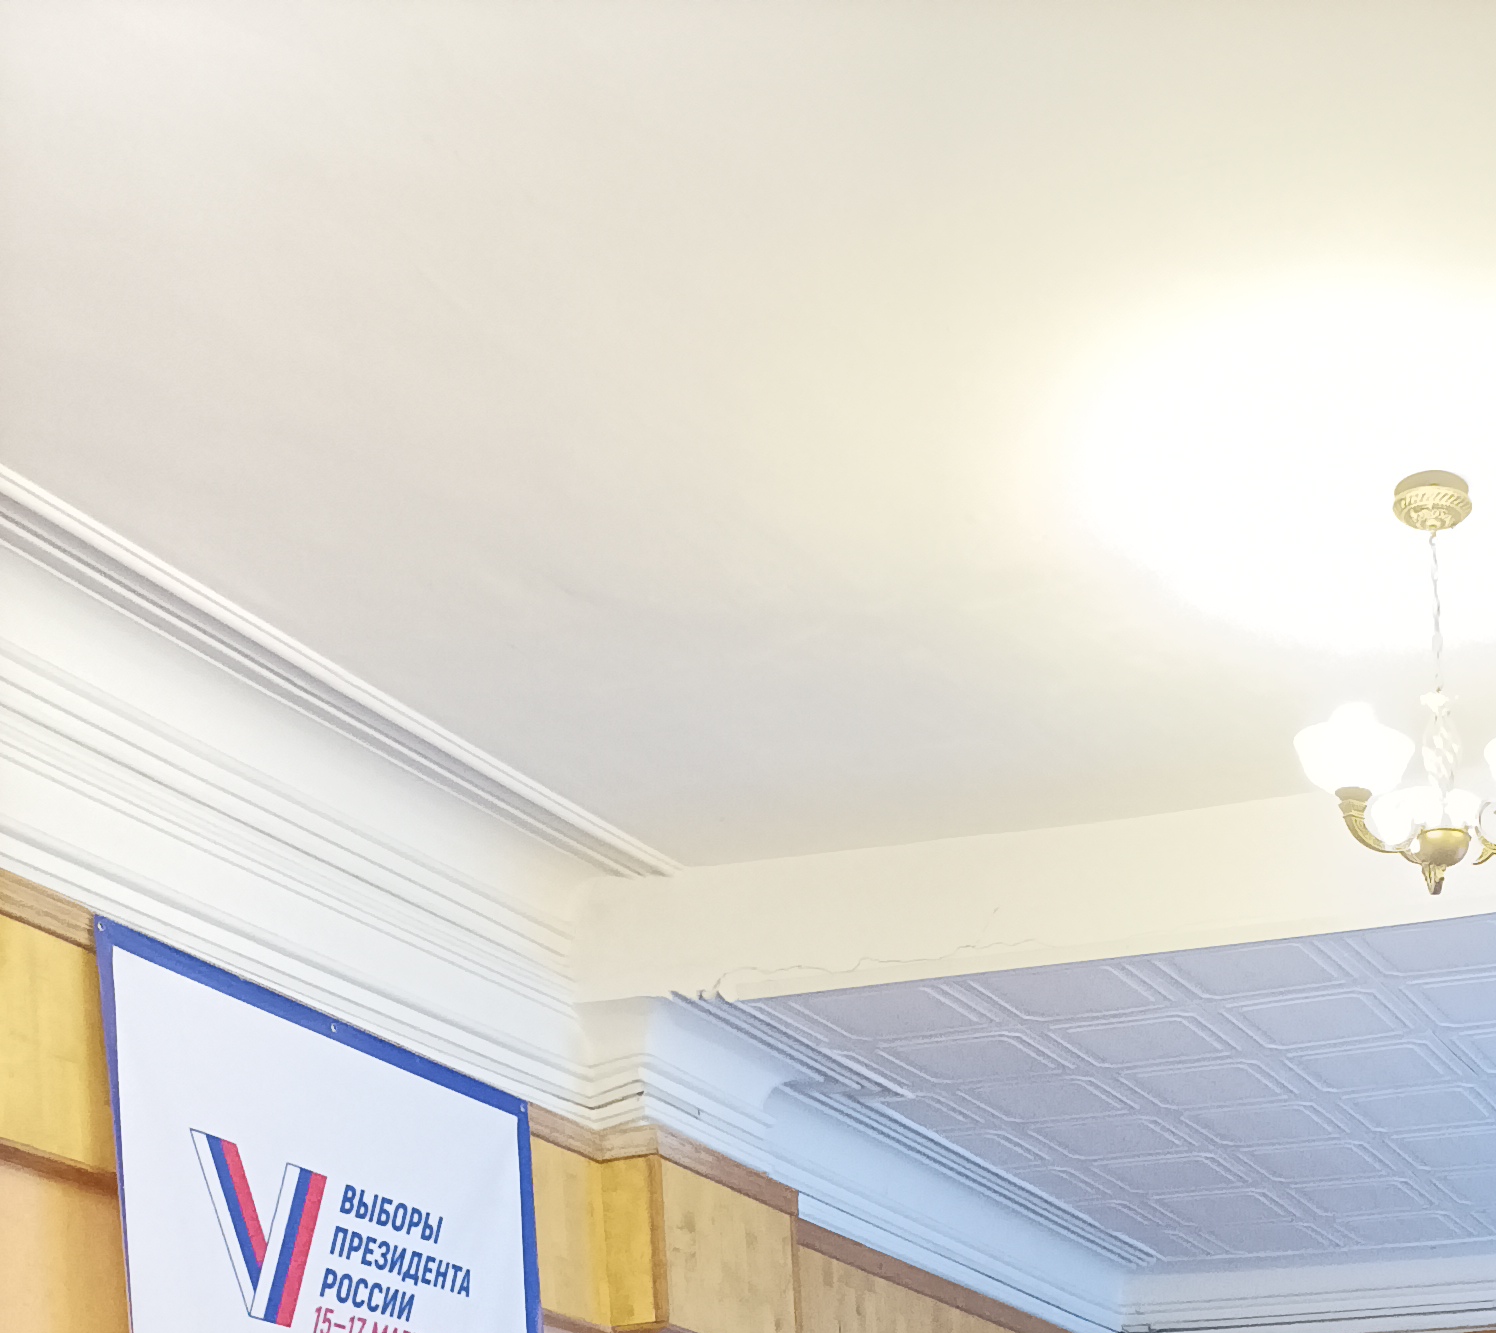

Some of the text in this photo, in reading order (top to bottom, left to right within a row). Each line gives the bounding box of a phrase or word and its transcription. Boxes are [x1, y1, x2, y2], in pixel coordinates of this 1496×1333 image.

[339, 1184, 443, 1244] ВЫБОРЫ
[329, 1225, 471, 1298] ПРЕЗИДЕНТА
[319, 1267, 415, 1322] РОССИИ
